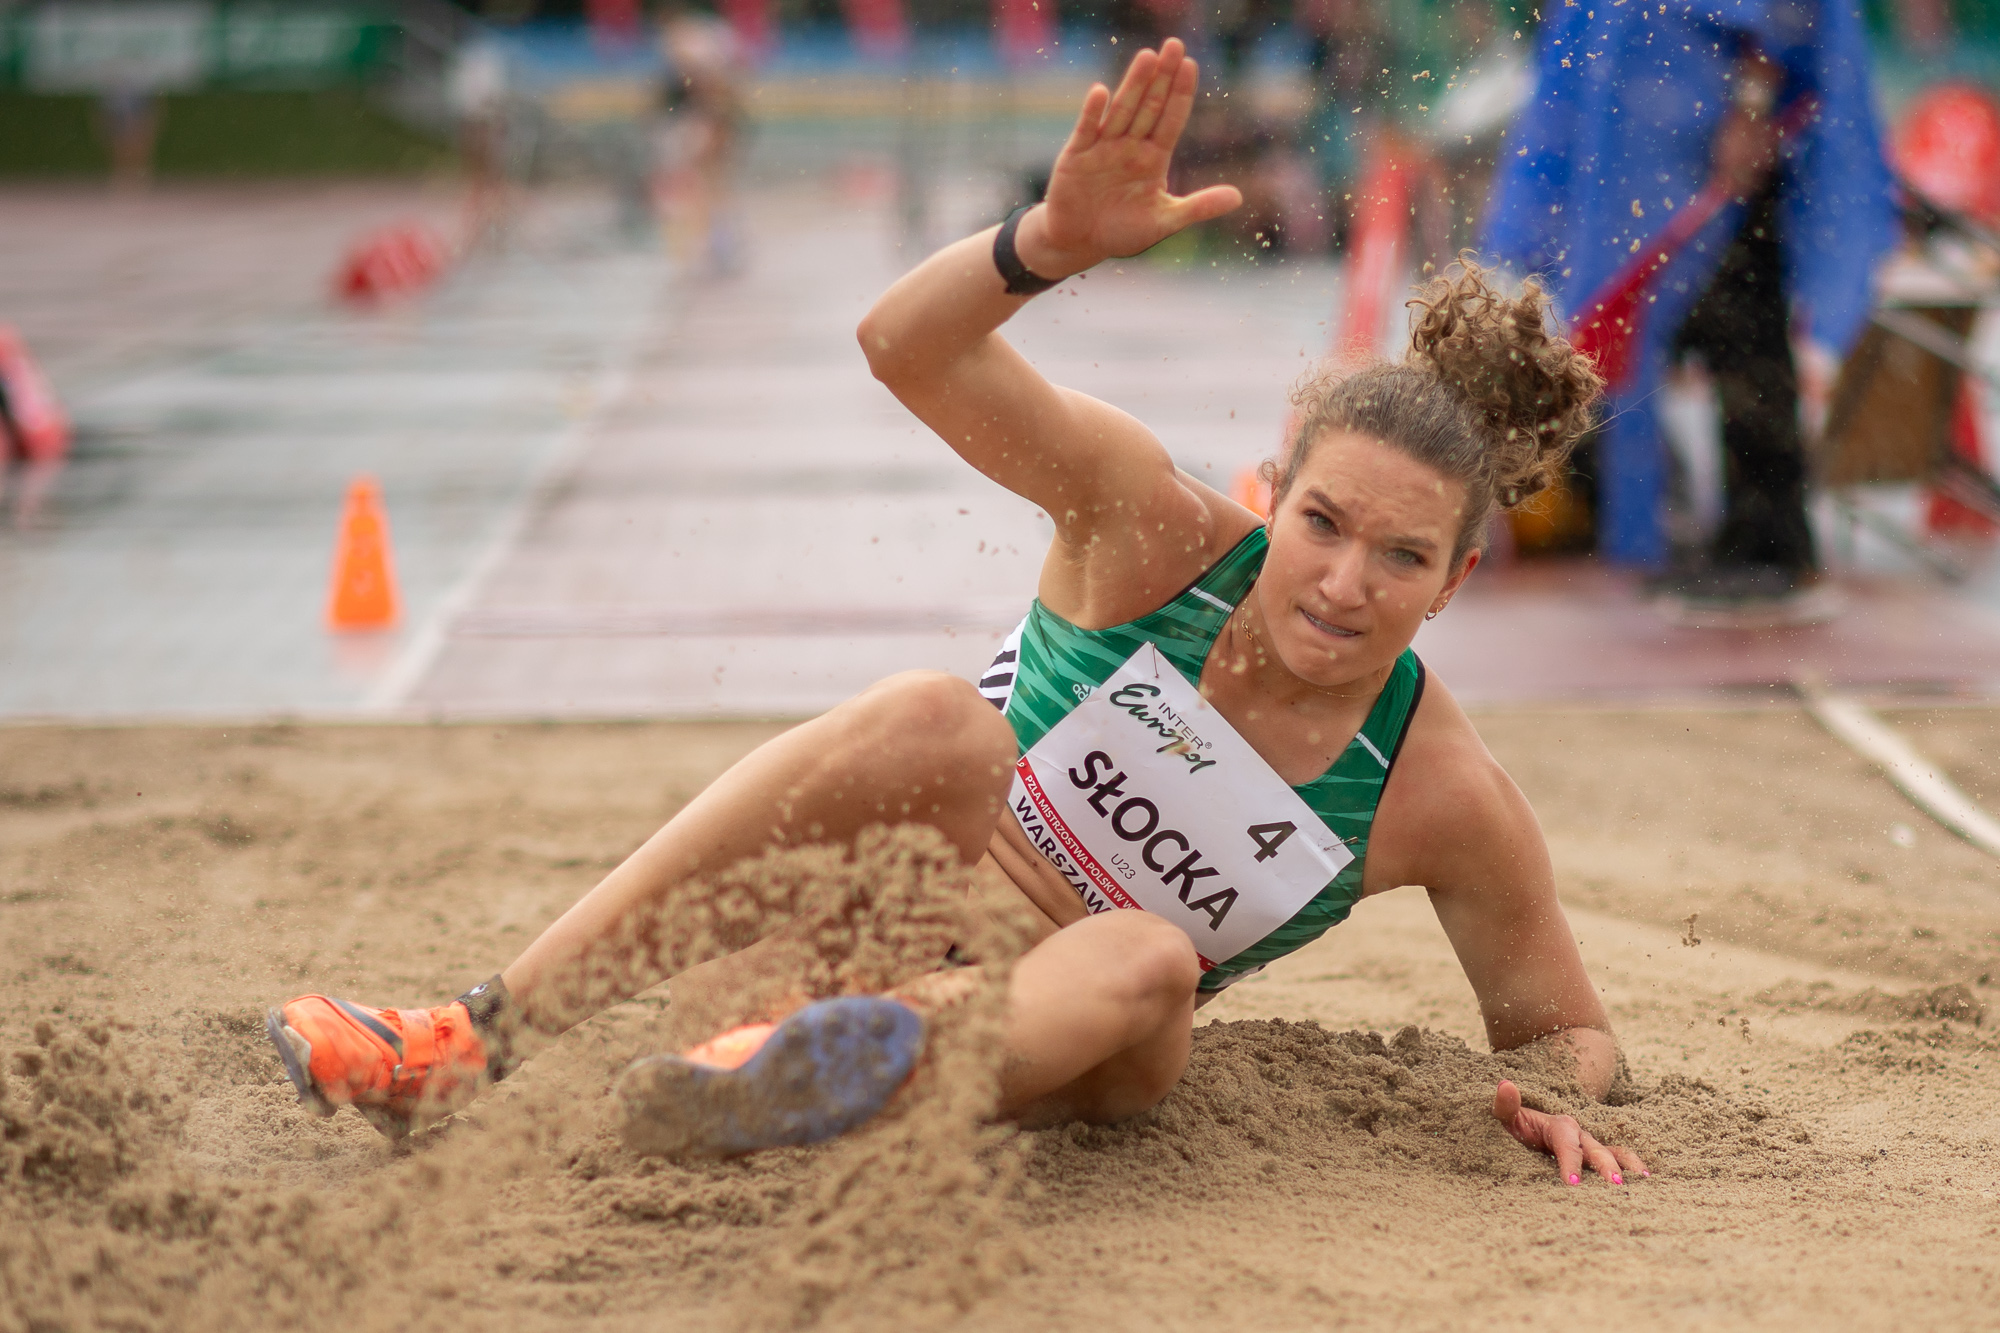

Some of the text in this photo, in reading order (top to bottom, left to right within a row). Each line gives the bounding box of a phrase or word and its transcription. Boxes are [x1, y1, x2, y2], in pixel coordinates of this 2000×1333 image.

[1016, 795, 1112, 915] WARSZAW
[1025, 774, 1126, 902] PZLA MISTRZOSTWA POLSKI W
[1068, 751, 1239, 931] SŁOCKA
[1111, 853, 1136, 879] U23
[1247, 821, 1297, 863] 4
